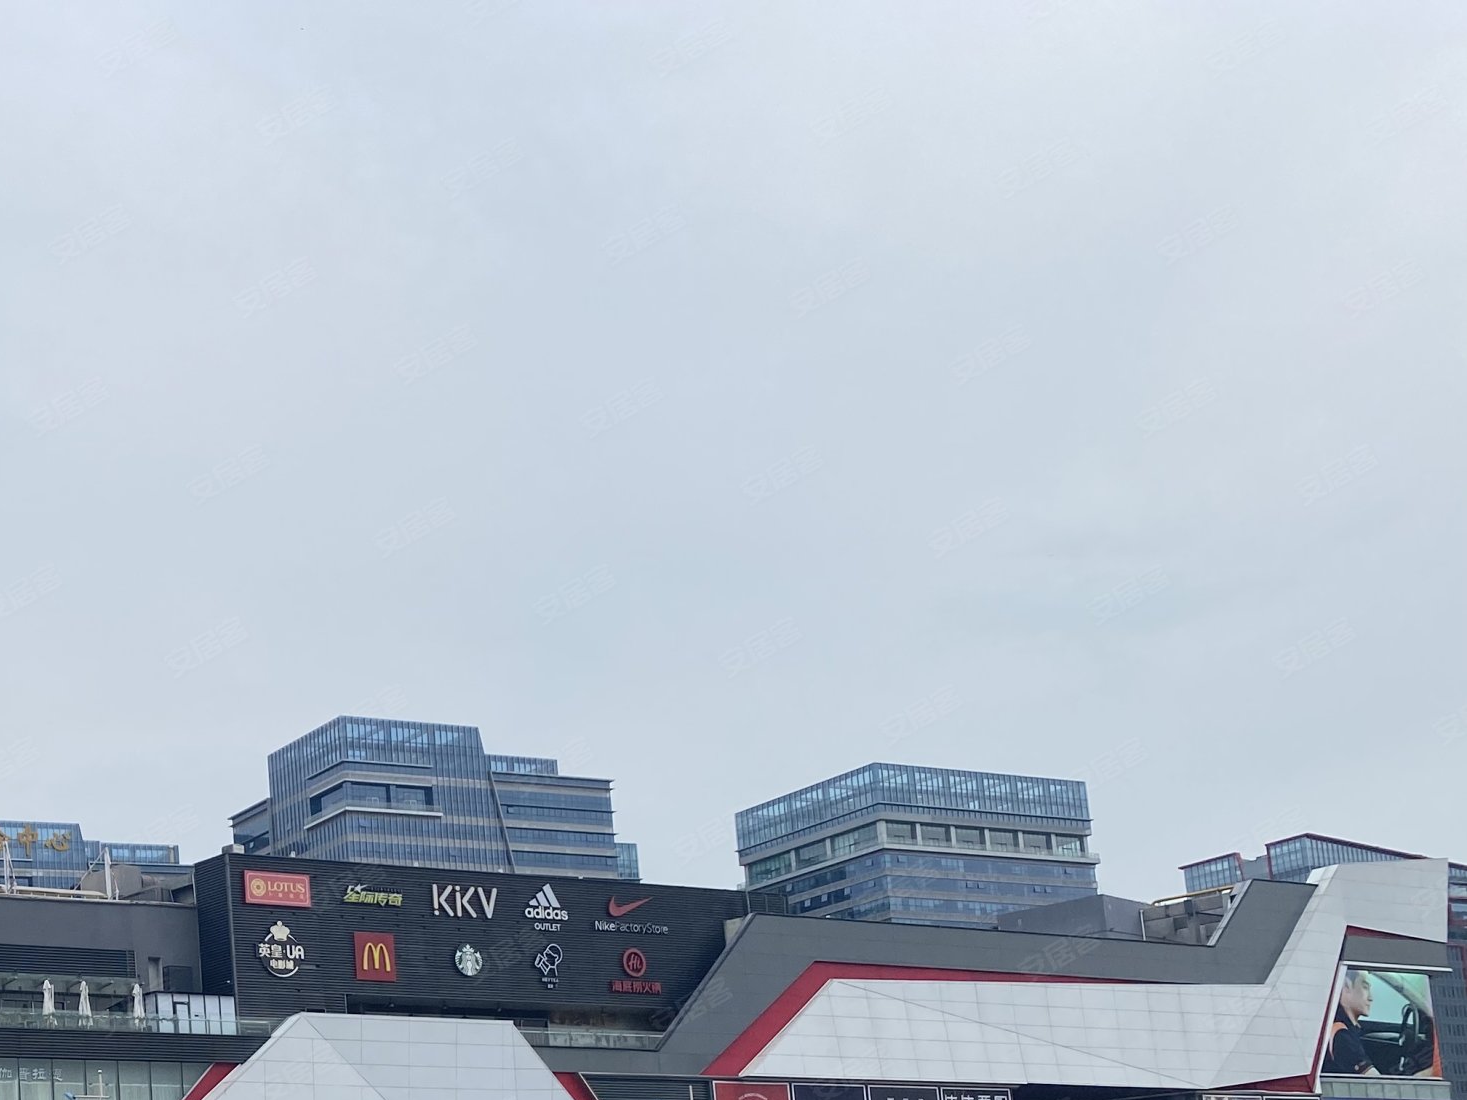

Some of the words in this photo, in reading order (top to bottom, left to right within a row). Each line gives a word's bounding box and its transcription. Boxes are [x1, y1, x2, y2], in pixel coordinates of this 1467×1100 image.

[267, 880, 306, 895] LOTUS
[524, 905, 569, 921] adidas
[534, 922, 561, 932] OUTLET
